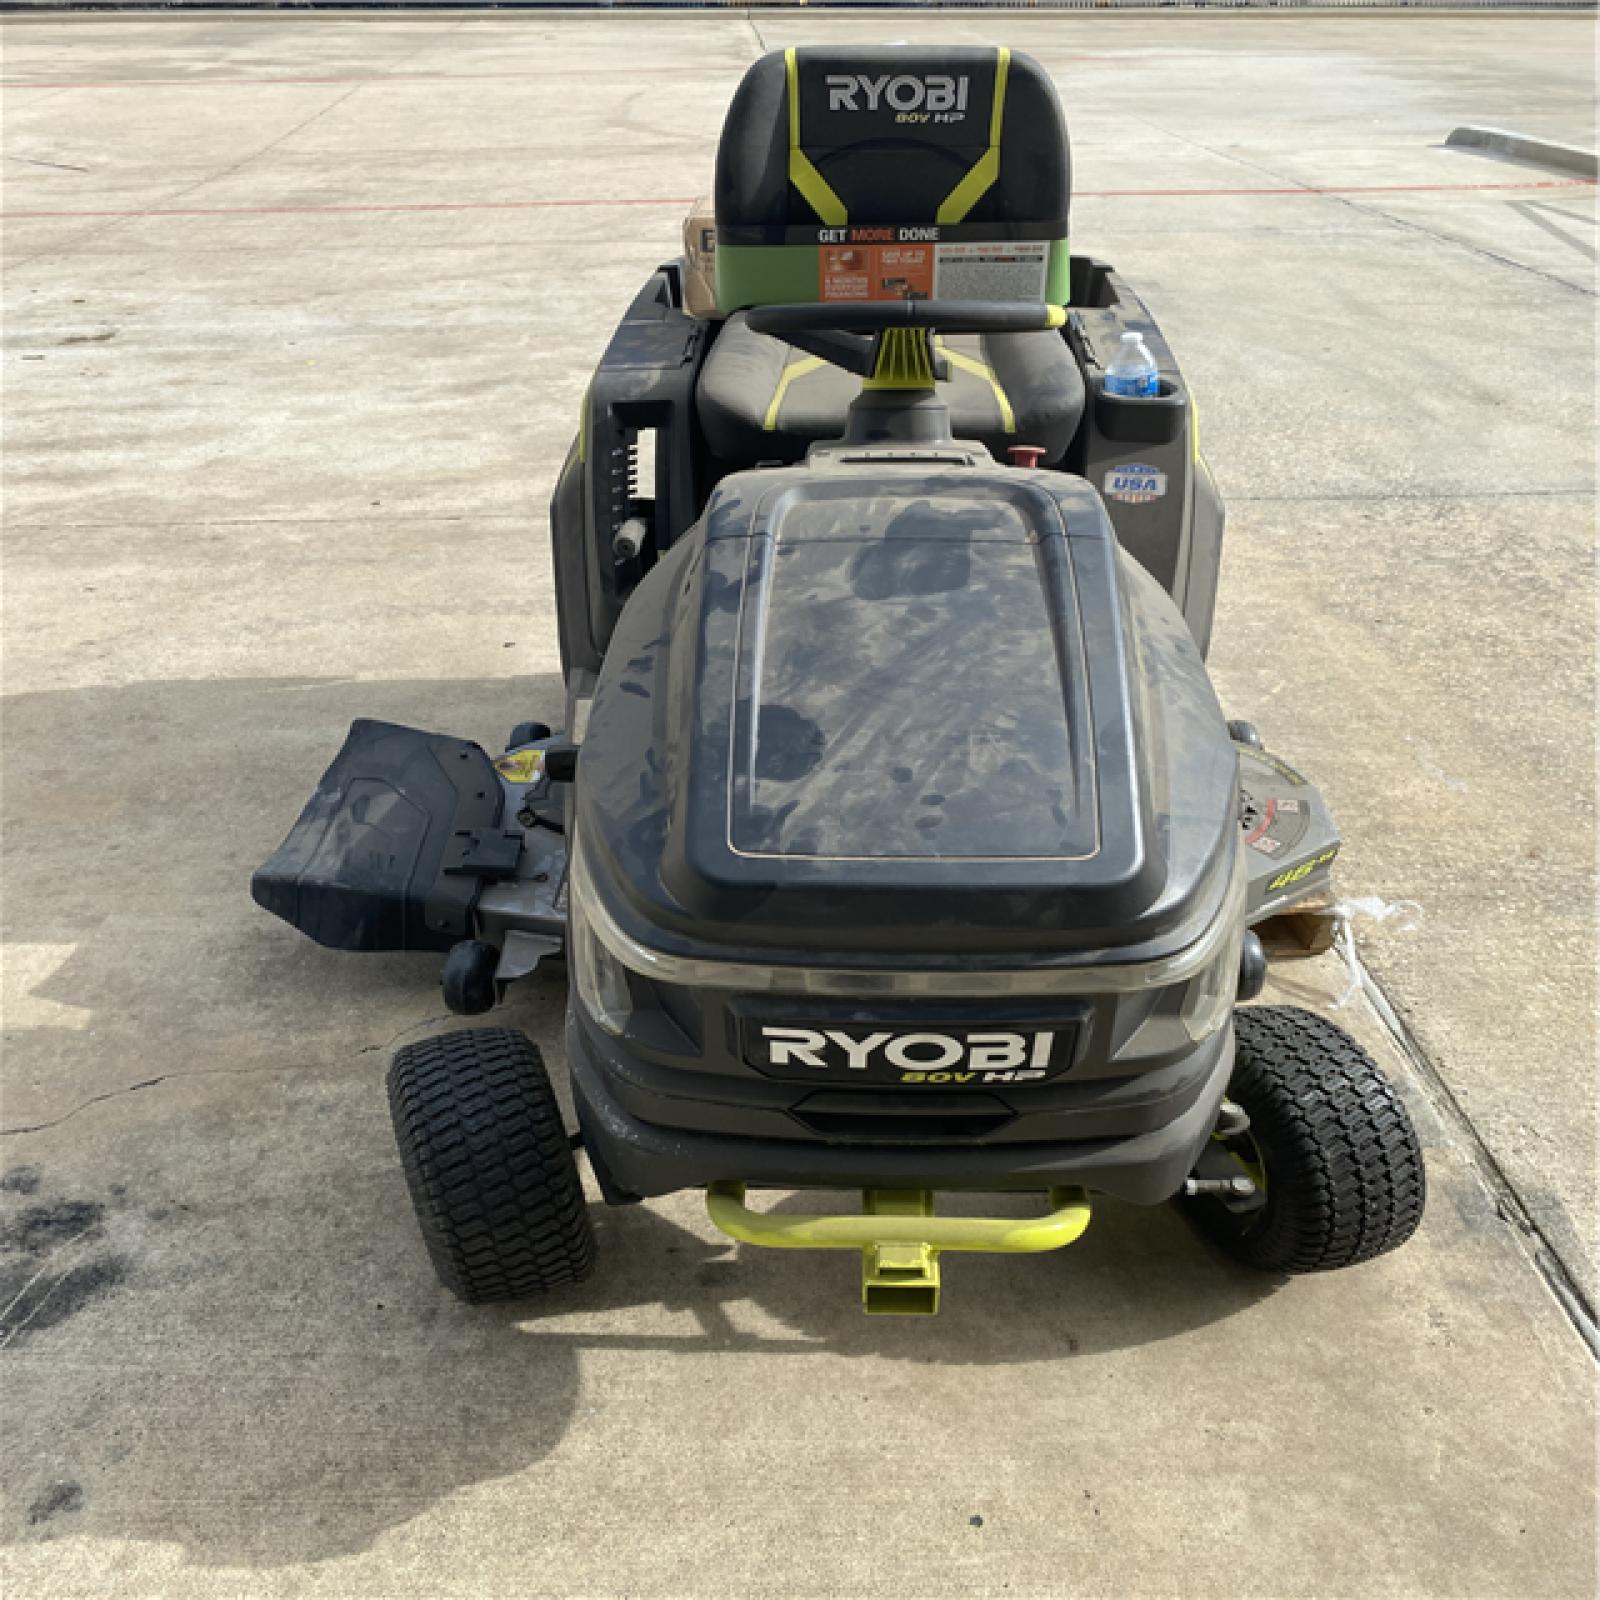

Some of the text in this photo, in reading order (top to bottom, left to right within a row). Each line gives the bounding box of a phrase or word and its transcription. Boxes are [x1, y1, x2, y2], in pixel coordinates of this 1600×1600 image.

[825, 74, 968, 111] RYOBI
[895, 112, 965, 123] 80V HP
[818, 227, 939, 242] GET MORE DONE
[1113, 477, 1156, 491] USA
[761, 1027, 1053, 1070] RYOBI
[901, 1070, 1046, 1083] 80V HP
